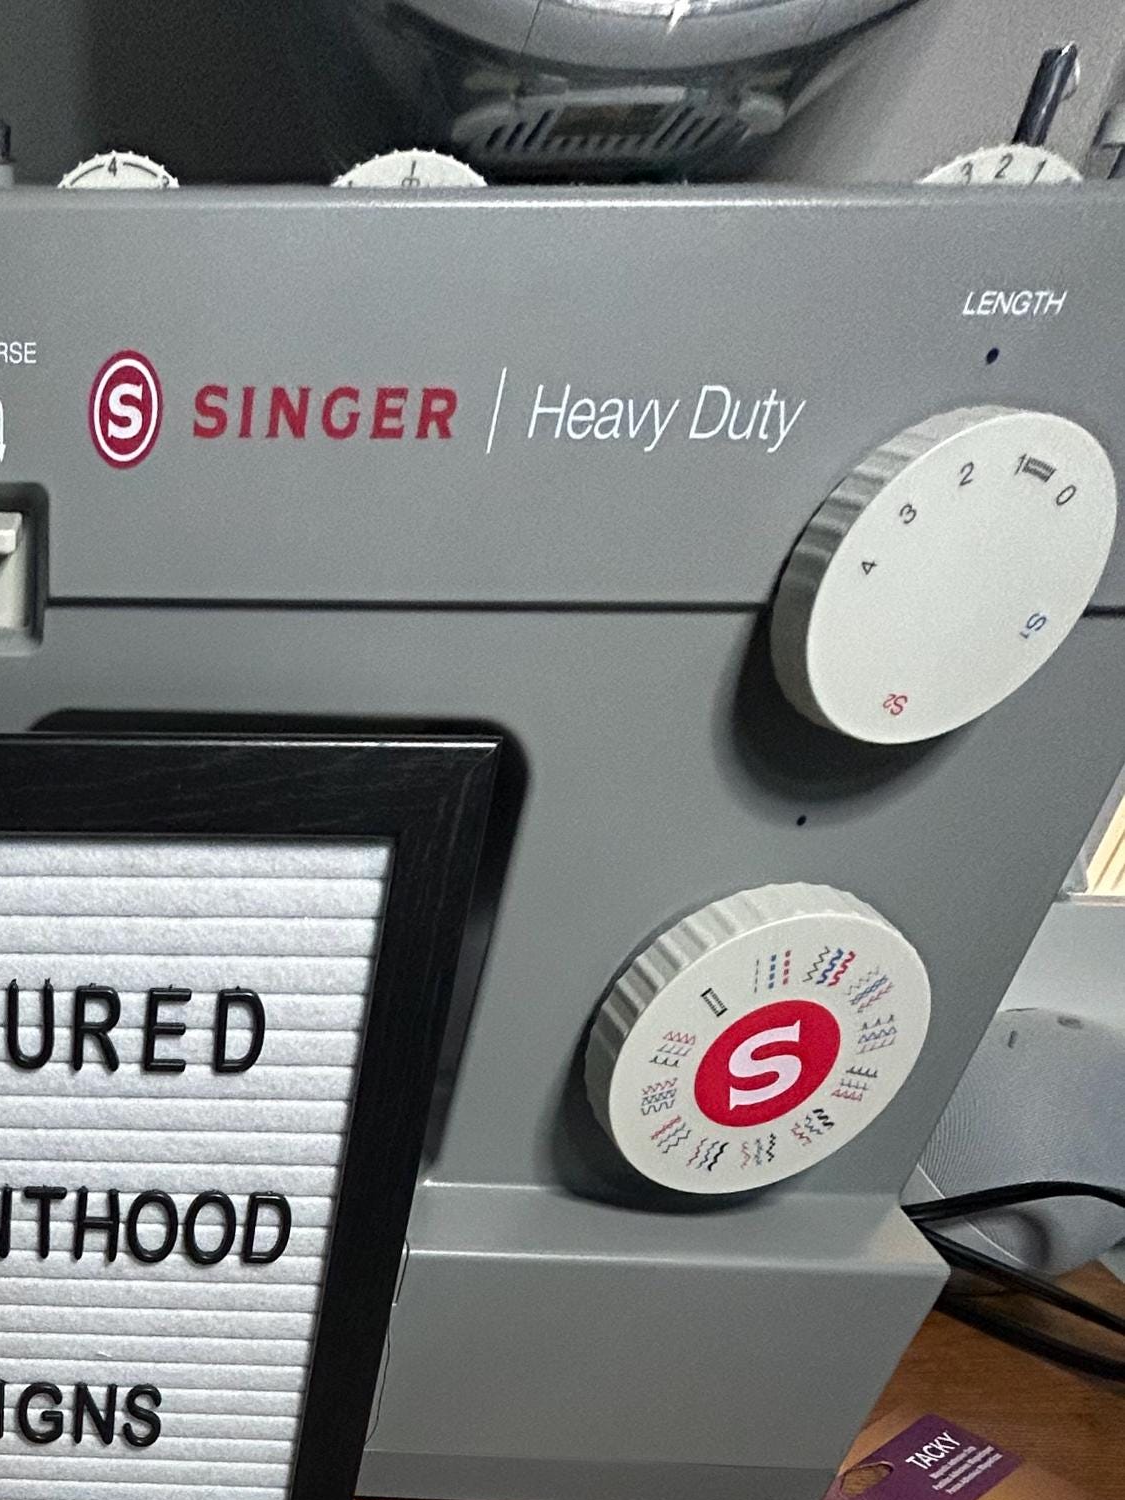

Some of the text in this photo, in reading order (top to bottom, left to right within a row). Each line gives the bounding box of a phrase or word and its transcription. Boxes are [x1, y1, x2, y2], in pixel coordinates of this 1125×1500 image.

[107, 156, 118, 177] 4
[994, 153, 1014, 179] 2
[1030, 159, 1048, 185] 1
[961, 290, 1068, 316] LENGTH
[191, 383, 459, 440] SINGER
[527, 384, 806, 453] Heavy Duty
[958, 461, 975, 487] 2
[1013, 453, 1027, 476] 1
[1055, 483, 1078, 507] 0
[898, 502, 918, 525] 3
[860, 560, 878, 576] 4
[905, 1430, 961, 1470] TACKY
